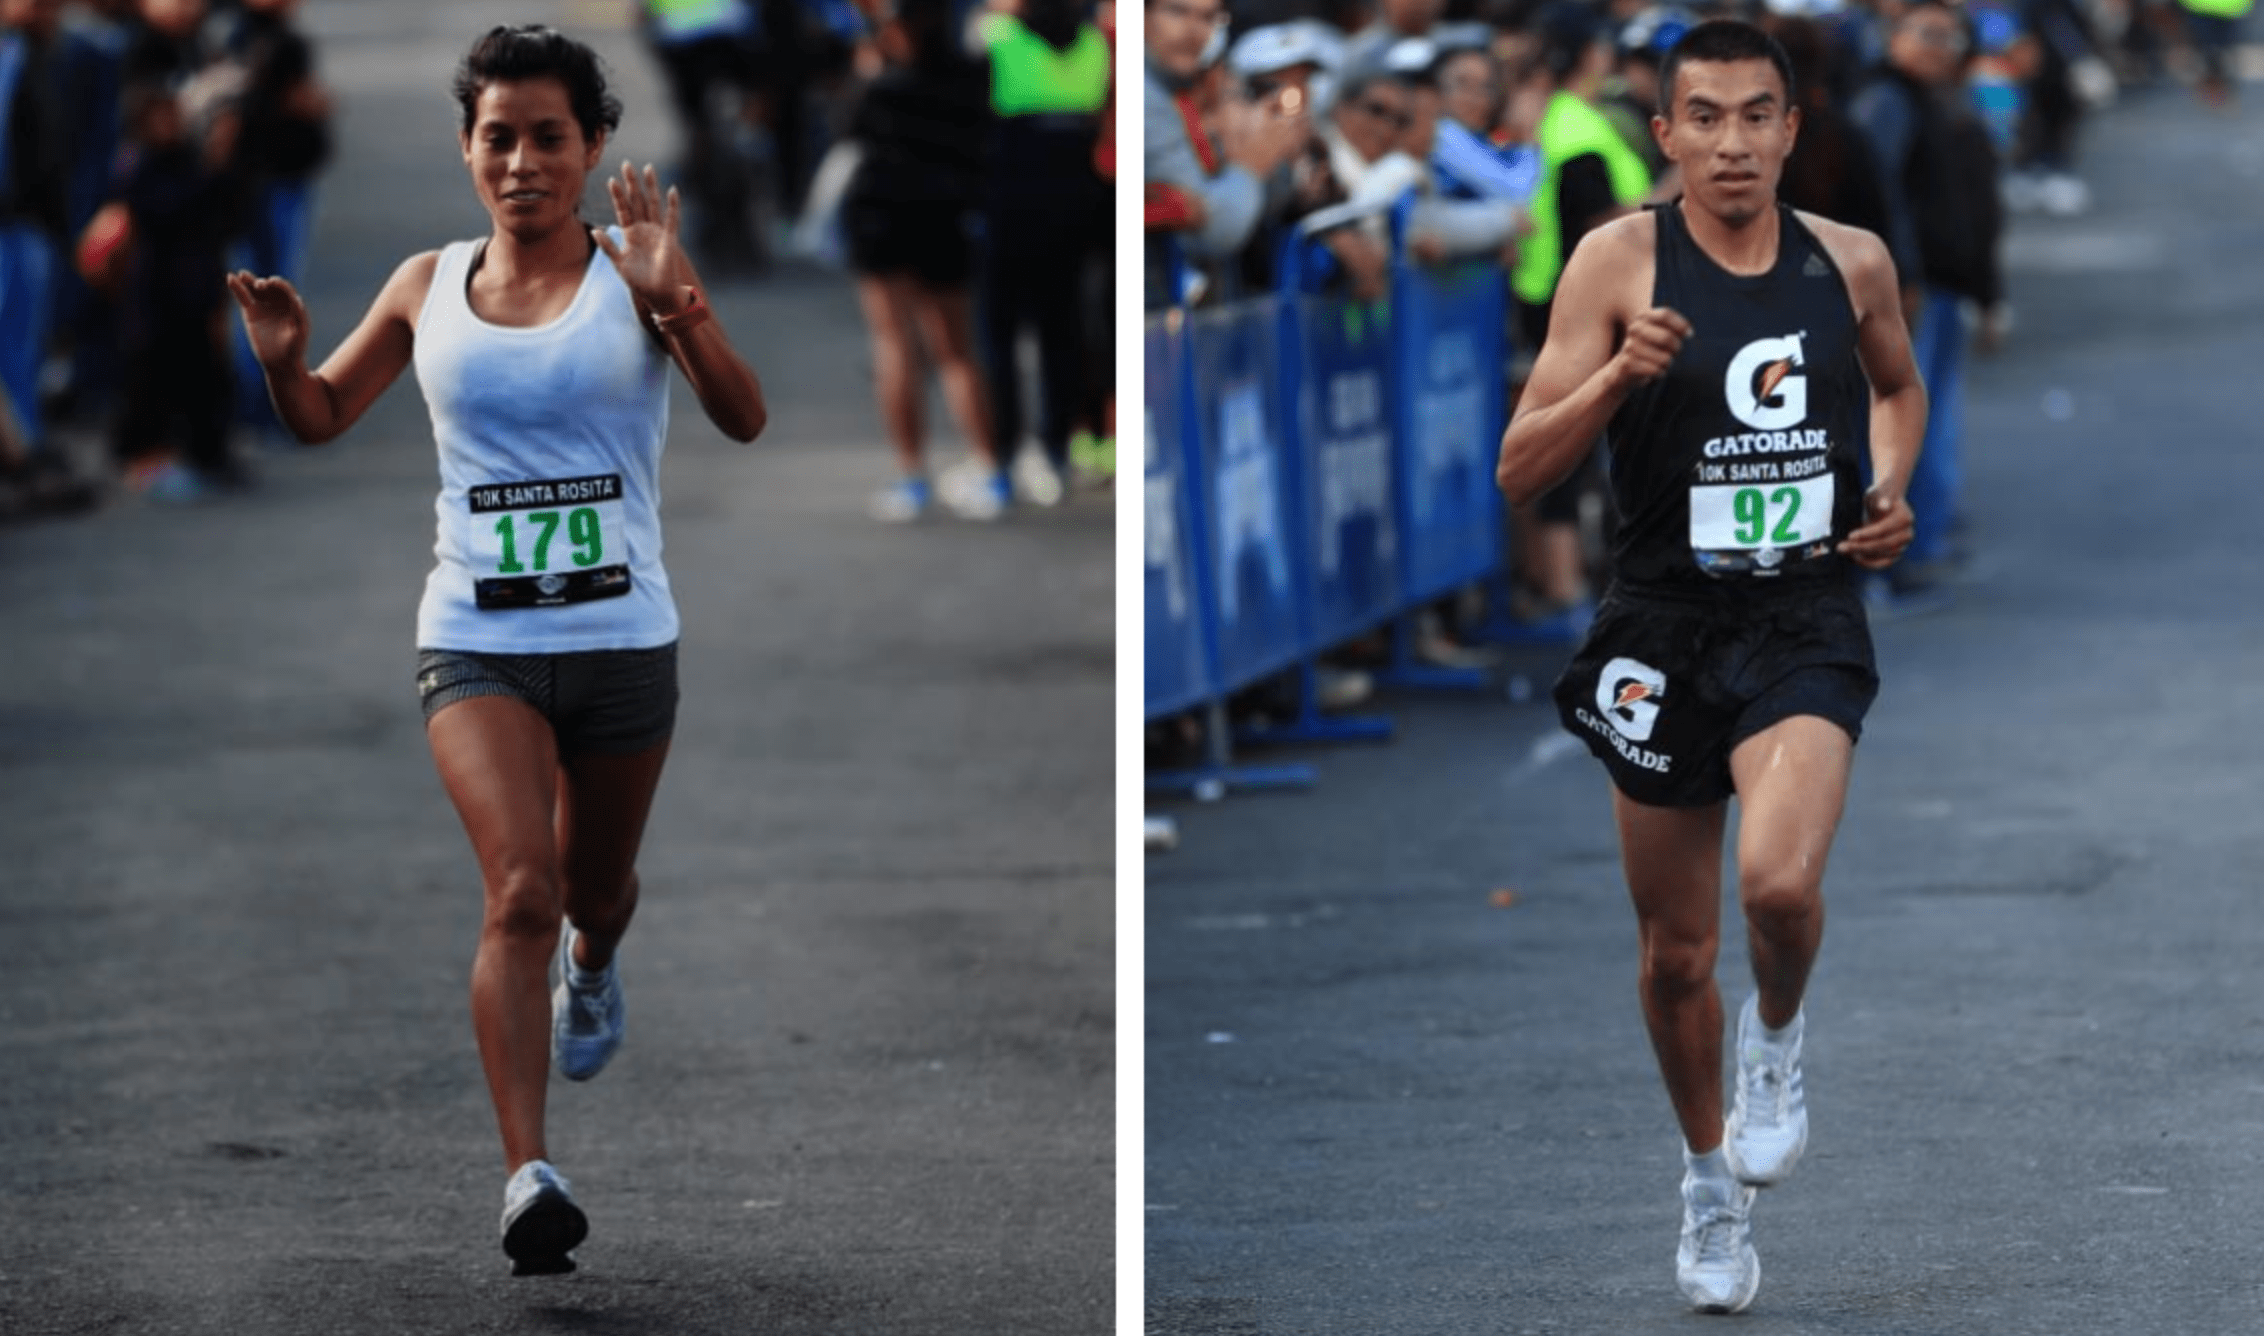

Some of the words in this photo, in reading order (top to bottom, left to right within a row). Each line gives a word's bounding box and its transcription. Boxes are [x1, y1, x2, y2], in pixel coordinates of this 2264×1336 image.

[1704, 429, 1827, 458] GATORADE
[1730, 463, 1779, 480] SANTA
[1784, 455, 1826, 478] ROSITA
[505, 485, 554, 504] SANTA
[559, 479, 614, 498] ROSITA
[1733, 485, 1802, 545] 92
[495, 507, 603, 573] 179
[1575, 707, 1672, 773] GATORADE
